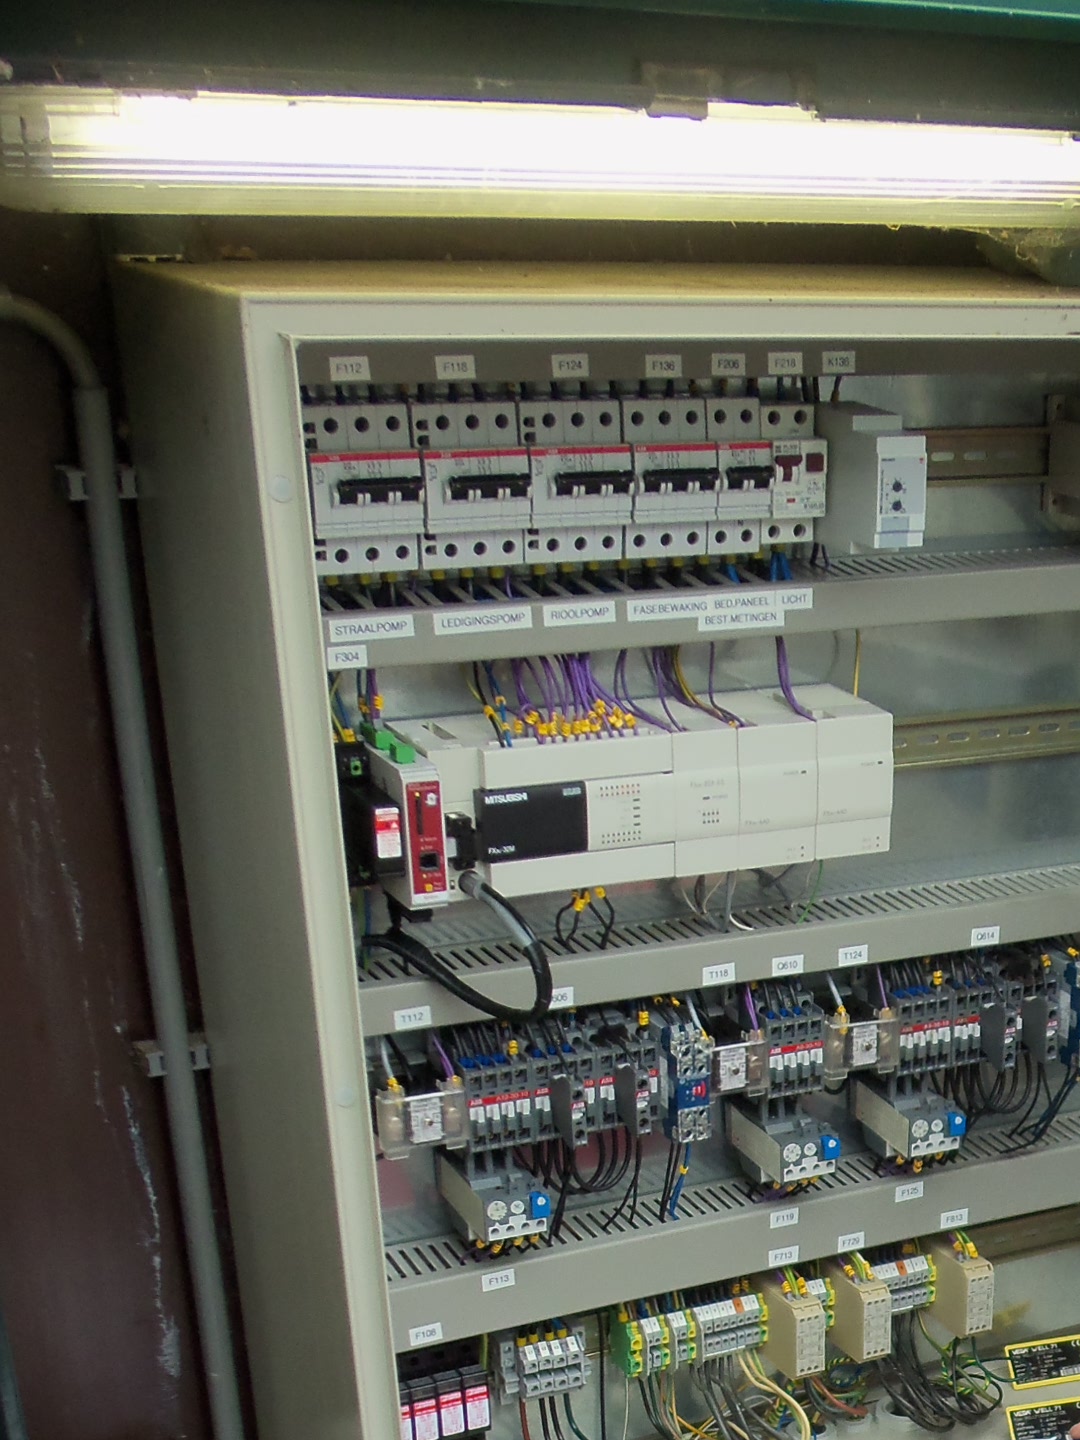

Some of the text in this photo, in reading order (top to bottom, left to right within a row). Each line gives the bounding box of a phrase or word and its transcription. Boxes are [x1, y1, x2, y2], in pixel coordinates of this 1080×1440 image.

[336, 363, 362, 374] F112
[443, 362, 469, 373] F118
[558, 360, 582, 371] F124
[652, 359, 675, 371] F136
[717, 359, 739, 369] F206
[782, 594, 808, 605] LICHT
[550, 606, 610, 620] RIOOLPOMP
[633, 601, 708, 615] FASEBEWAKING
[441, 612, 526, 629] LEDIGINGSPOMP
[335, 621, 407, 636] STRAALPOMP
[334, 652, 360, 663] F304
[844, 950, 863, 960] T124
[709, 968, 729, 980] T118
[401, 1012, 424, 1023] T112
[774, 1250, 793, 1262] F713
[489, 1274, 510, 1286] F113
